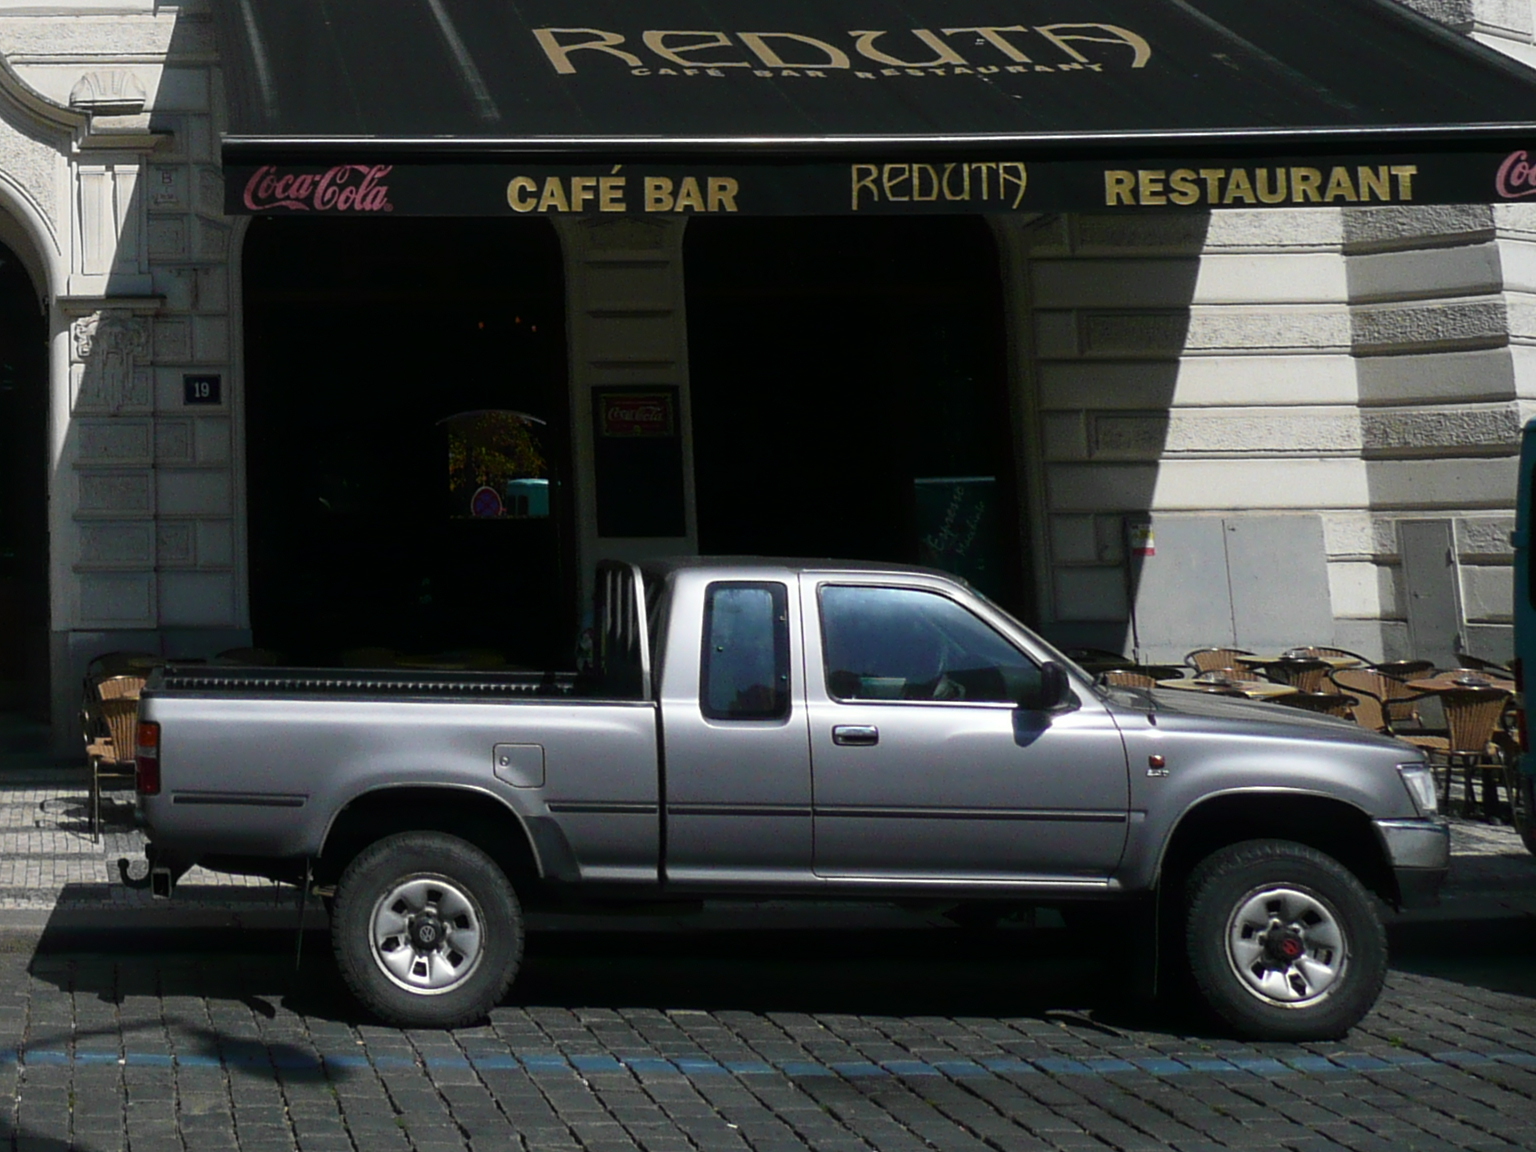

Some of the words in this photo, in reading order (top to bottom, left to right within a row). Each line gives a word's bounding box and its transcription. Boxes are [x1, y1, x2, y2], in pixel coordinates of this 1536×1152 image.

[631, 66, 726, 78] CAFÉ
[752, 69, 828, 79] BAR
[854, 62, 1104, 80] RESTAURANT
[244, 164, 391, 212] Coca-Cola
[506, 164, 629, 213] CAFÉ
[644, 176, 739, 213] BAR
[1105, 164, 1418, 207] RESTAURANT
[194, 382, 210, 398] 19
